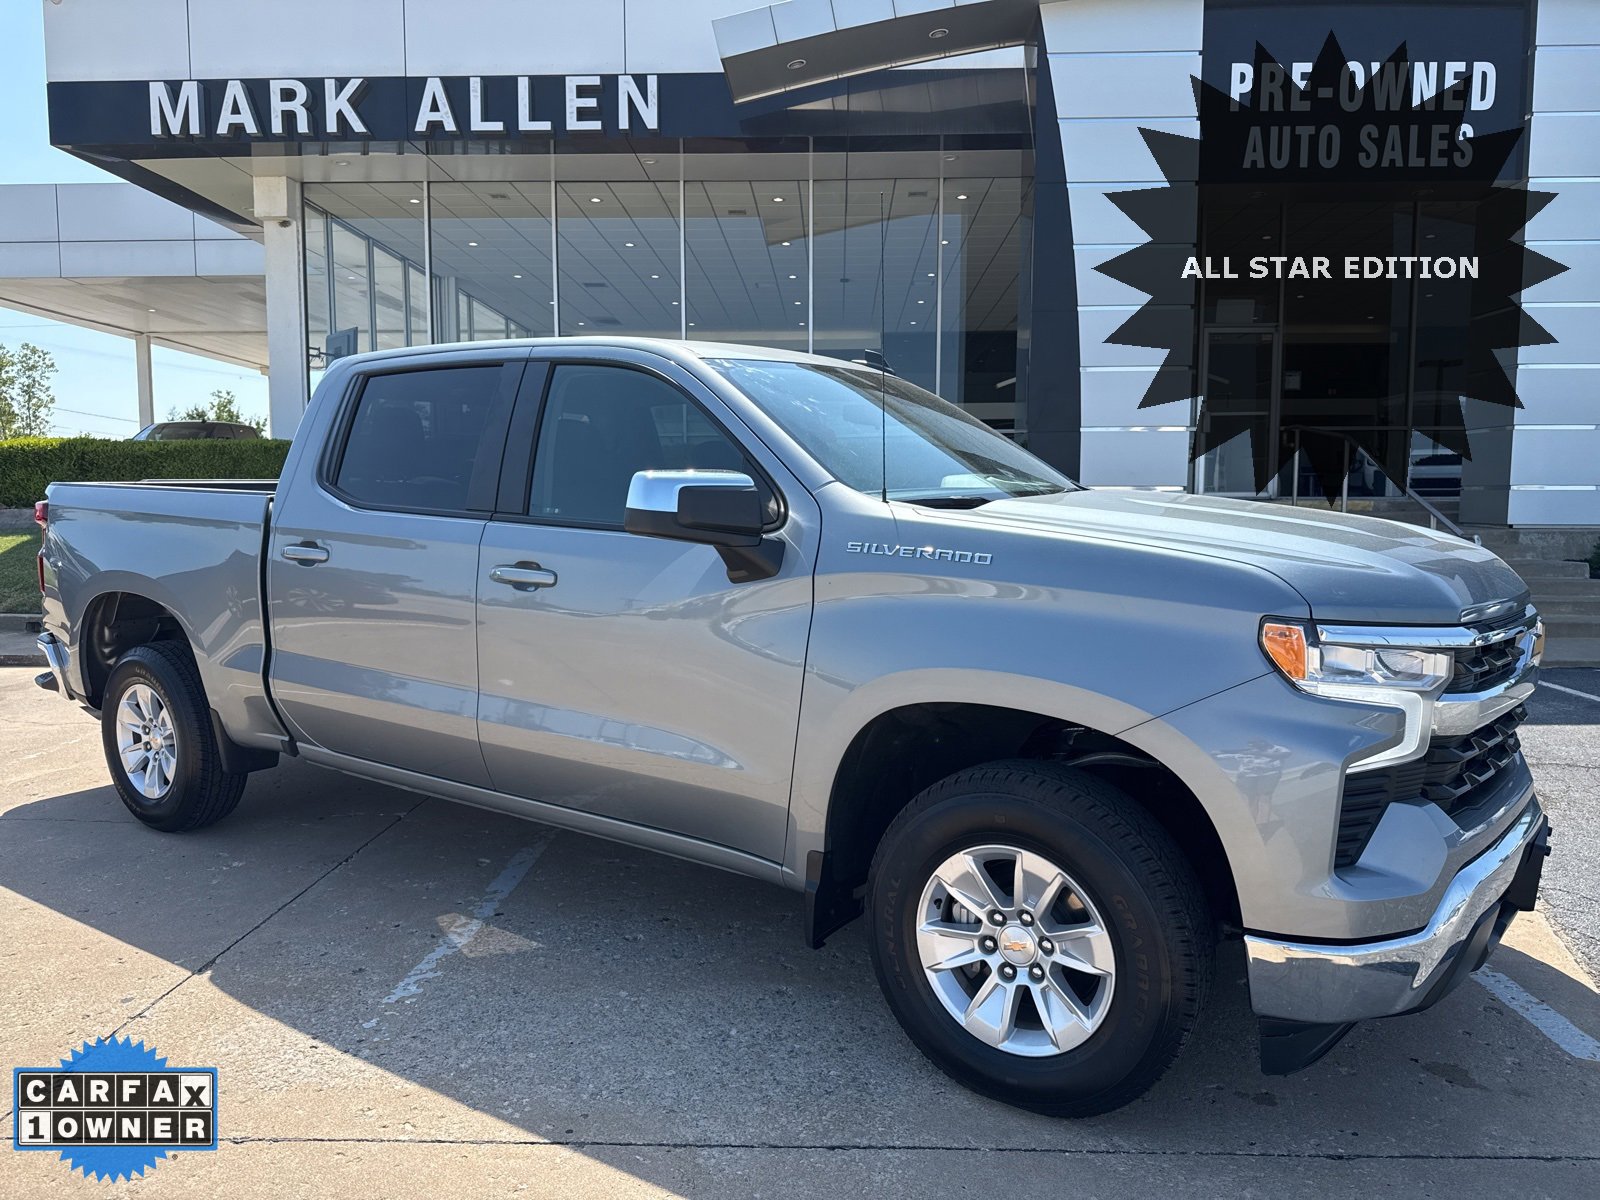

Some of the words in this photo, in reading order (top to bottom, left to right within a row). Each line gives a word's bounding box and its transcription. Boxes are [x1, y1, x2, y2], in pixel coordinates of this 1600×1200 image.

[149, 78, 368, 136] MARK
[414, 75, 659, 132] ALLEN
[1230, 61, 1497, 112] PRE-OWNED
[1243, 124, 1341, 168] AUTO
[1357, 123, 1474, 168] SALES
[847, 541, 993, 566] SILVERADO
